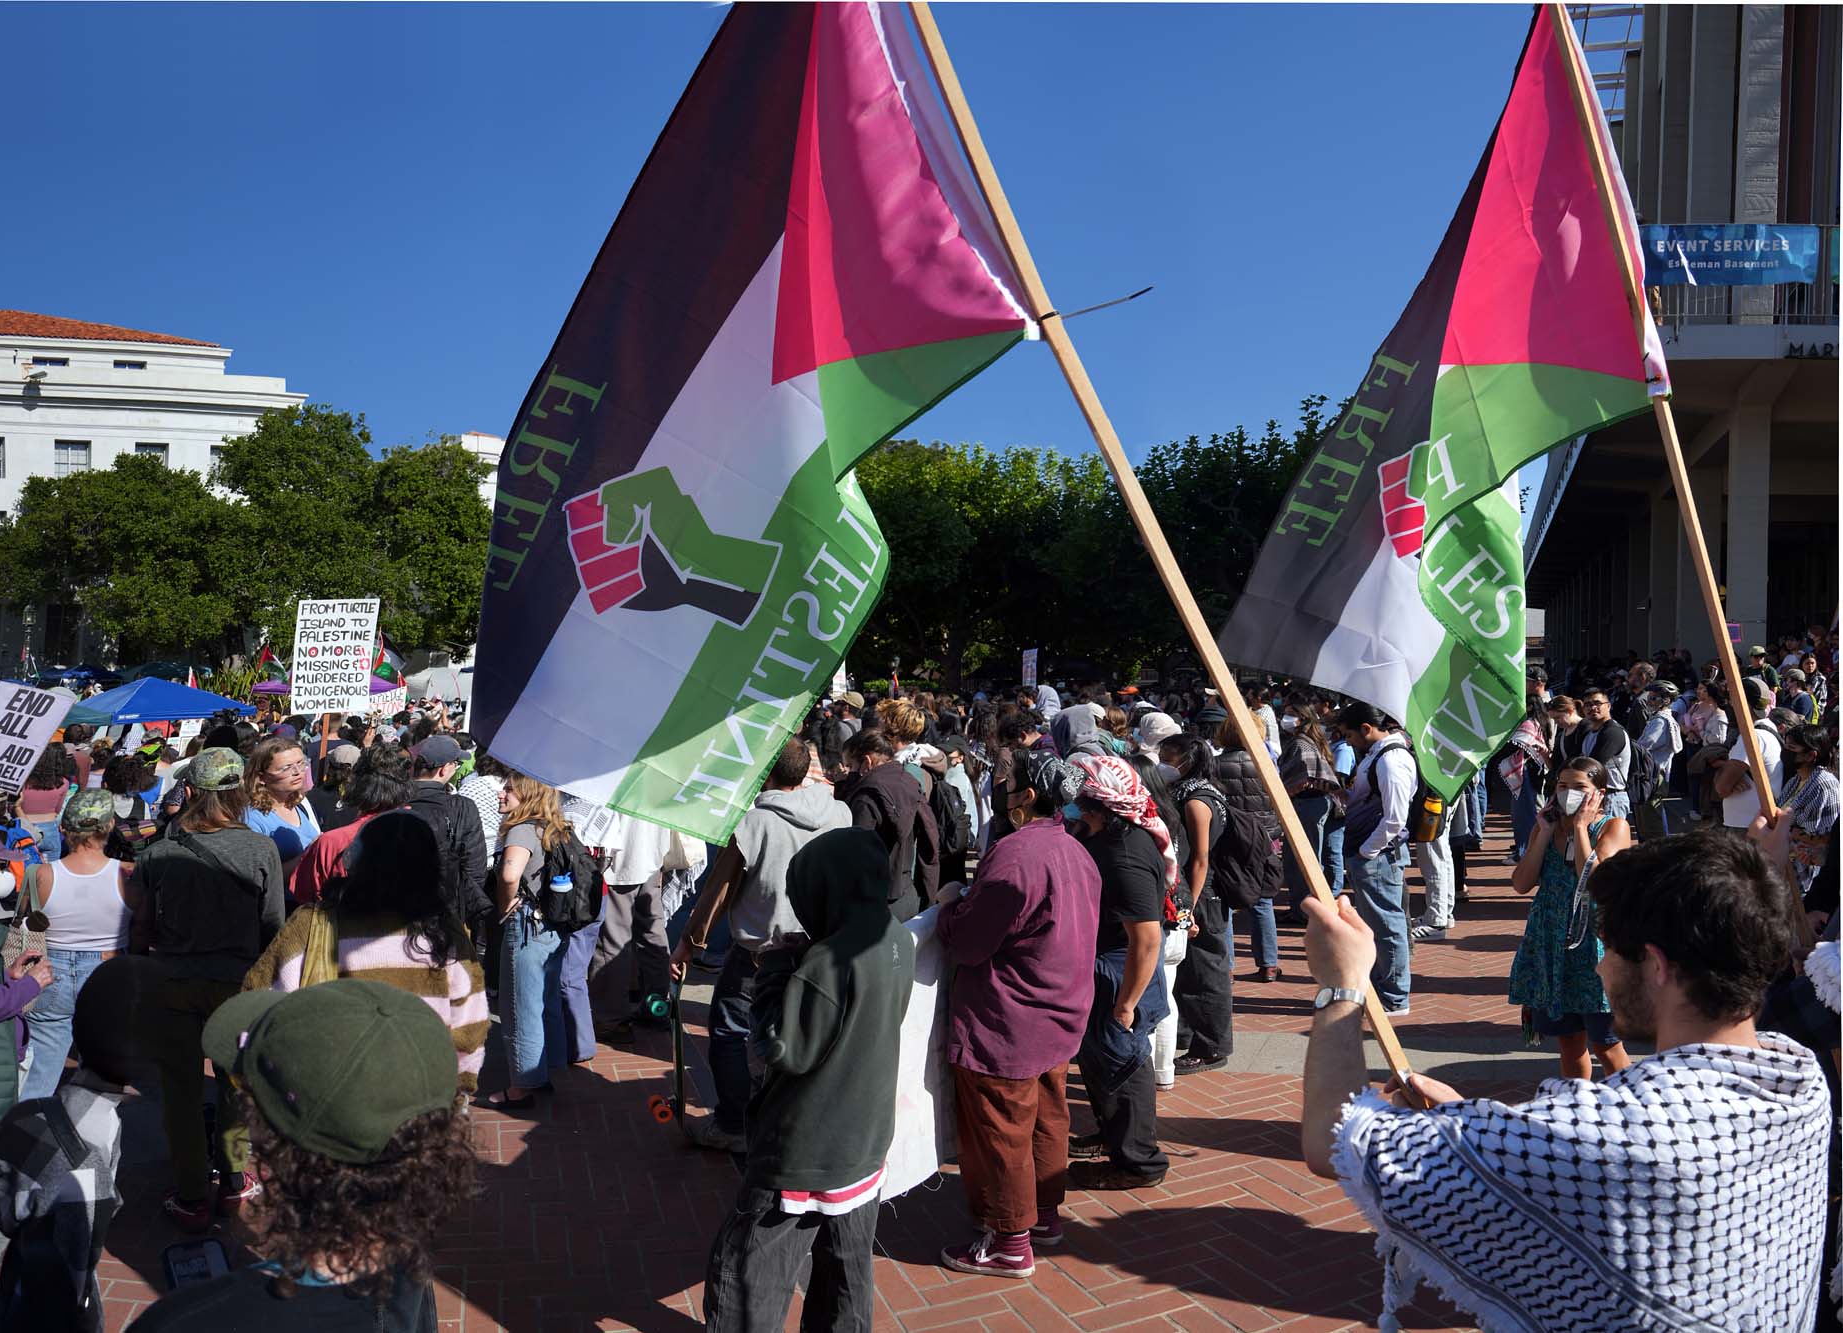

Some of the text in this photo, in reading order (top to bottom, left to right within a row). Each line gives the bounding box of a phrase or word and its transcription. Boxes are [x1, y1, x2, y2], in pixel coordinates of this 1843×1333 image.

[1656, 238, 1790, 253] EVENT SERVICES
[1668, 259, 1780, 269] Eseman Basement
[1789, 341, 1839, 357] MAR
[301, 602, 377, 616] FROM TURTLE
[300, 617, 369, 630] ISLAND TO
[299, 630, 371, 643] PALESTINE
[298, 646, 318, 658] NO
[296, 659, 350, 672] MISSING
[295, 672, 365, 684] MURDERED
[294, 685, 369, 697] INDIGENOUS
[5, 688, 56, 718] END
[294, 698, 351, 711] WOMEN!
